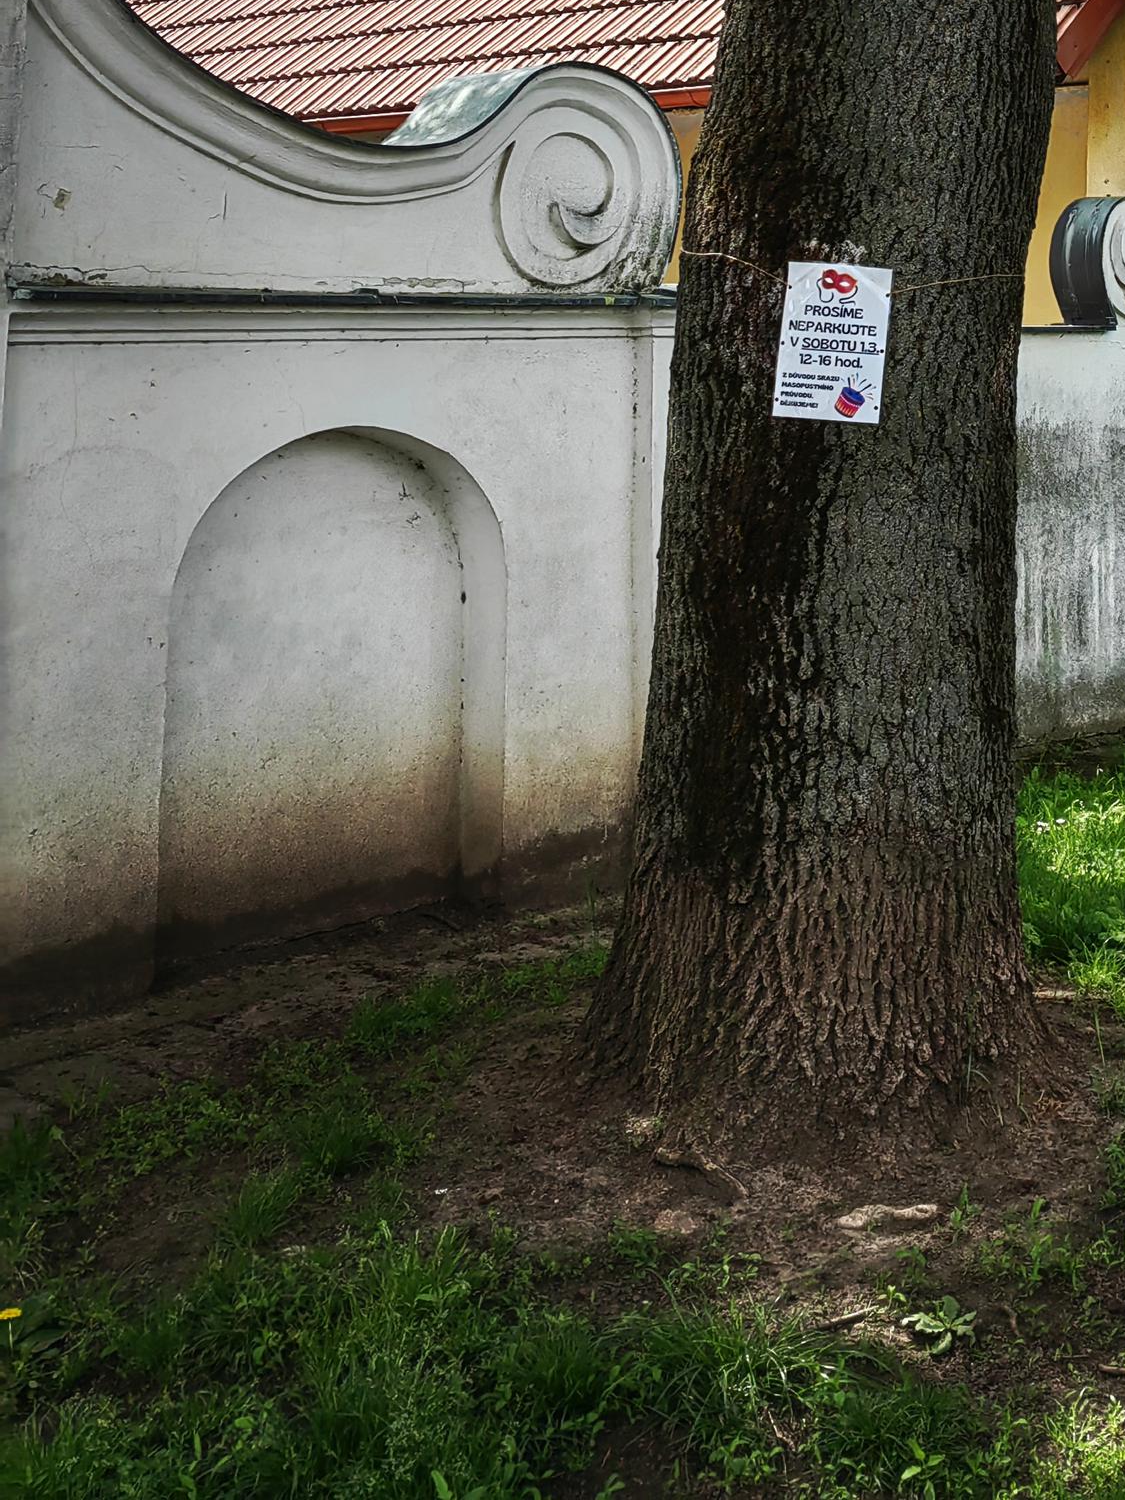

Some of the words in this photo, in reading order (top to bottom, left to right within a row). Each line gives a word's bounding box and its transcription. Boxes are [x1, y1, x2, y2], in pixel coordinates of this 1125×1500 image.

[804, 304, 864, 319] PROSÍME
[788, 320, 877, 336] NEPARKUJTE
[790, 336, 799, 347] V
[801, 338, 857, 351] SOBOTU
[860, 341, 880, 353] 1.3.
[799, 354, 832, 366] 12-16
[834, 356, 863, 368] hod.
